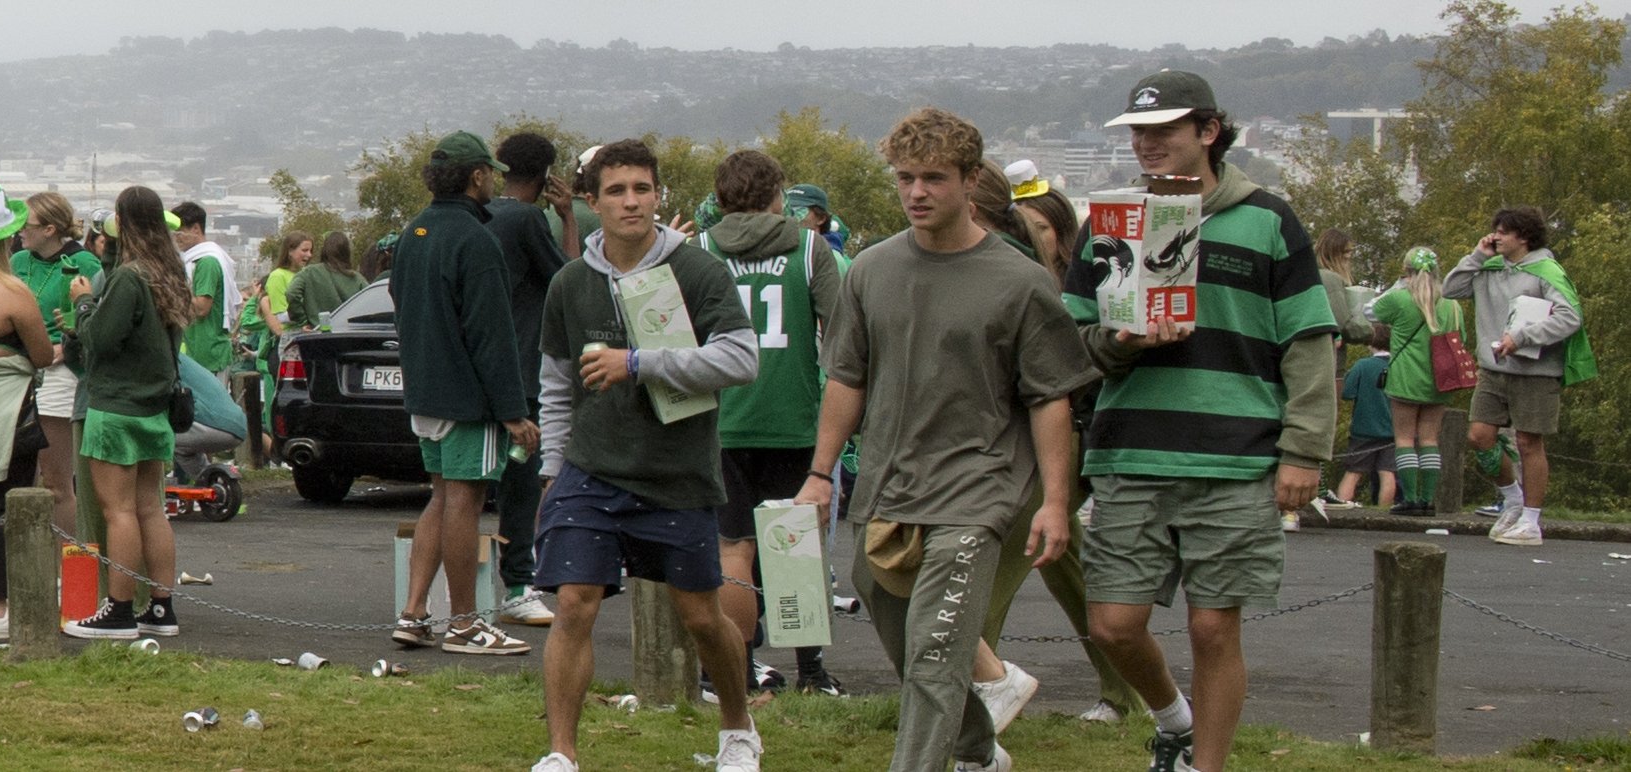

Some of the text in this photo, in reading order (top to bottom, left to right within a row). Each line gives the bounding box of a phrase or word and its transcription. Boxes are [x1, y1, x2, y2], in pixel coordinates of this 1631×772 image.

[1126, 206, 1142, 237] Tui
[726, 255, 788, 279] IRVING
[779, 594, 801, 630] GLACIAL
[923, 535, 978, 662] BARKERS
